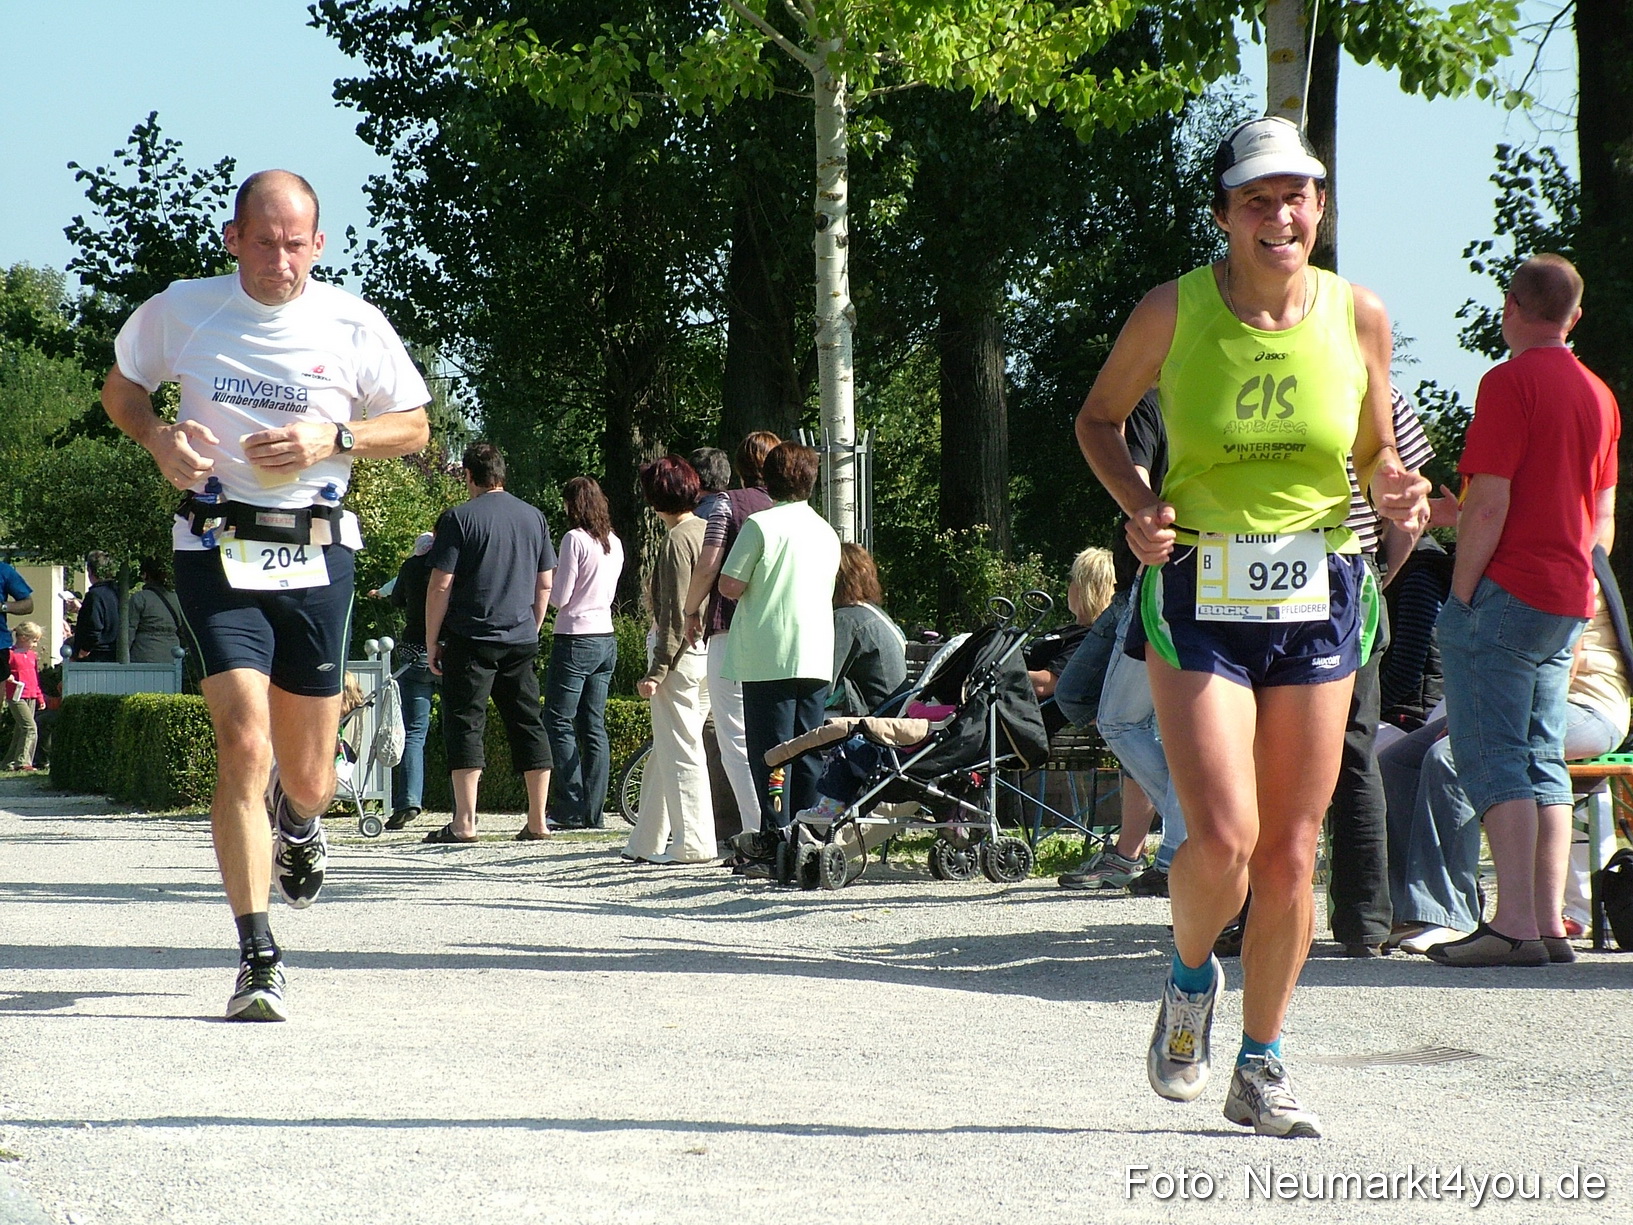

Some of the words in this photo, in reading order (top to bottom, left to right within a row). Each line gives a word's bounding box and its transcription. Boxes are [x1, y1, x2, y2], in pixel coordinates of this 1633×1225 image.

[214, 376, 307, 402] uniVersa
[1235, 373, 1298, 420] CIS
[211, 391, 308, 413] NürnbergMarathon
[1223, 420, 1308, 435] AMBERG
[1237, 442, 1307, 453] INTERSPORT
[1239, 452, 1291, 460] LANGE
[225, 548, 233, 559] B
[260, 545, 308, 571] 204
[1203, 554, 1211, 570] B
[1248, 560, 1308, 591] 928
[1198, 605, 1249, 615] BOCK
[1281, 603, 1327, 614] PFLEIDERER
